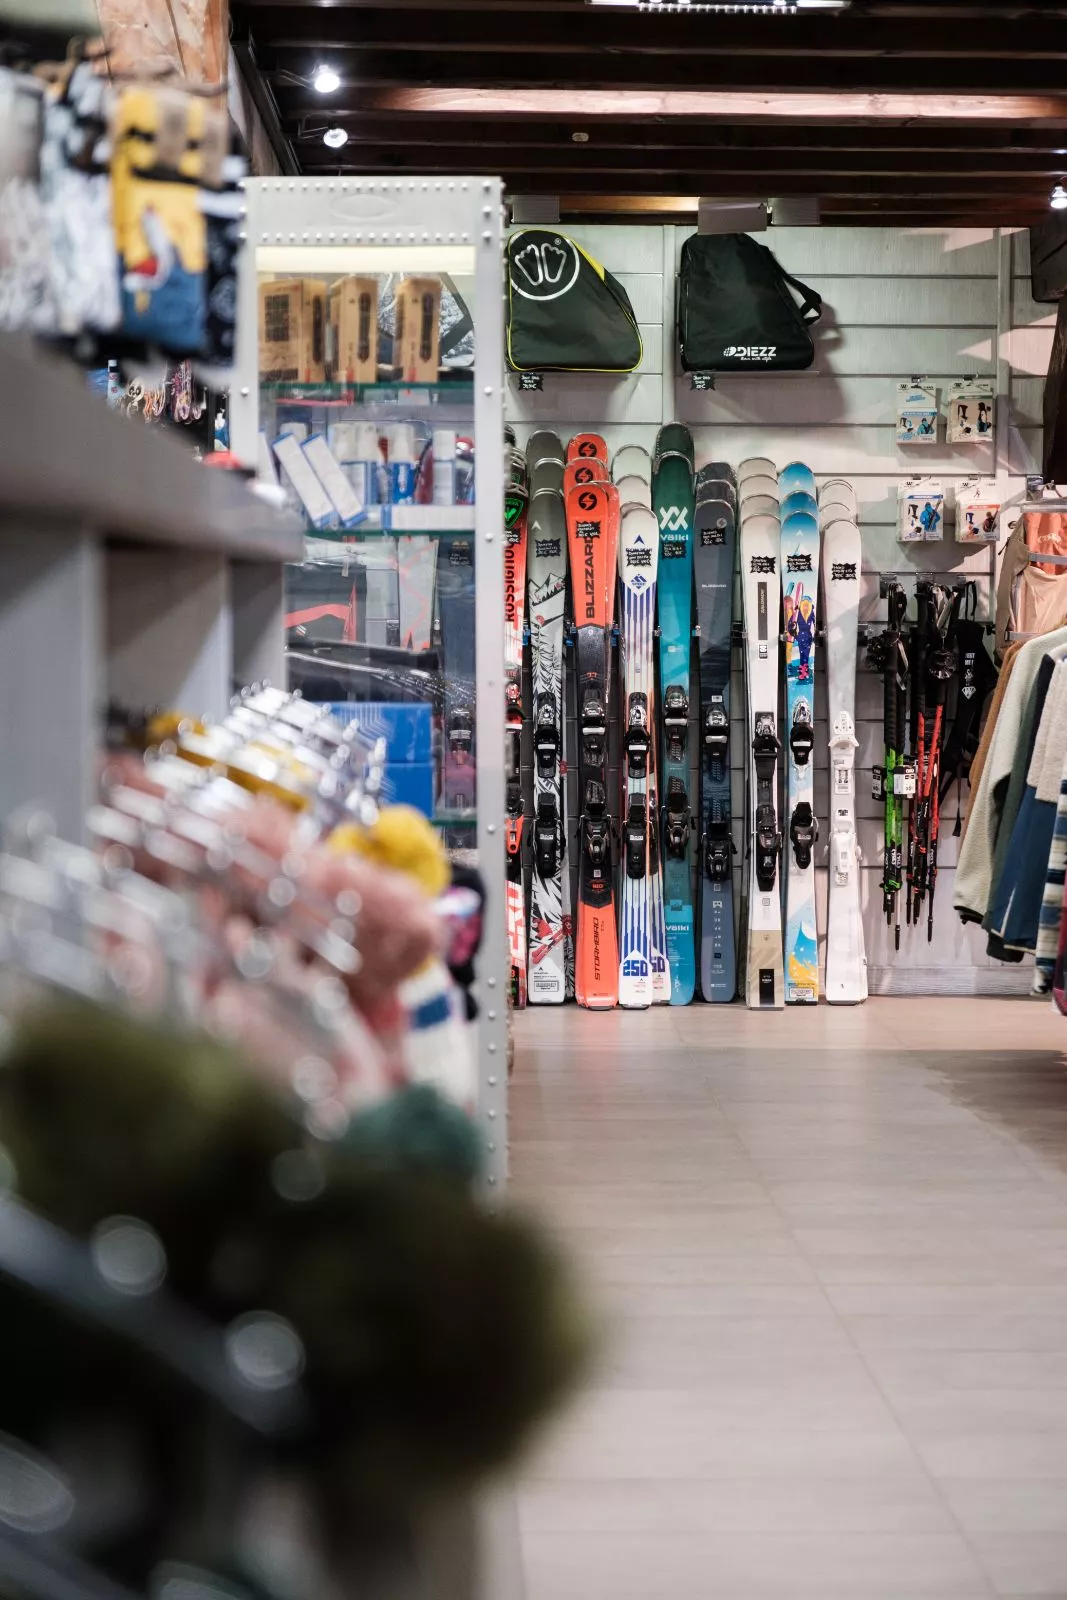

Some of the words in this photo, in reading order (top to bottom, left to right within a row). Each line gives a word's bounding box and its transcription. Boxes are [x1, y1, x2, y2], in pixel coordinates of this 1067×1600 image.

[734, 346, 777, 357] DIEZZ
[593, 917, 601, 981] STORMBIRD
[622, 959, 649, 976] 250
